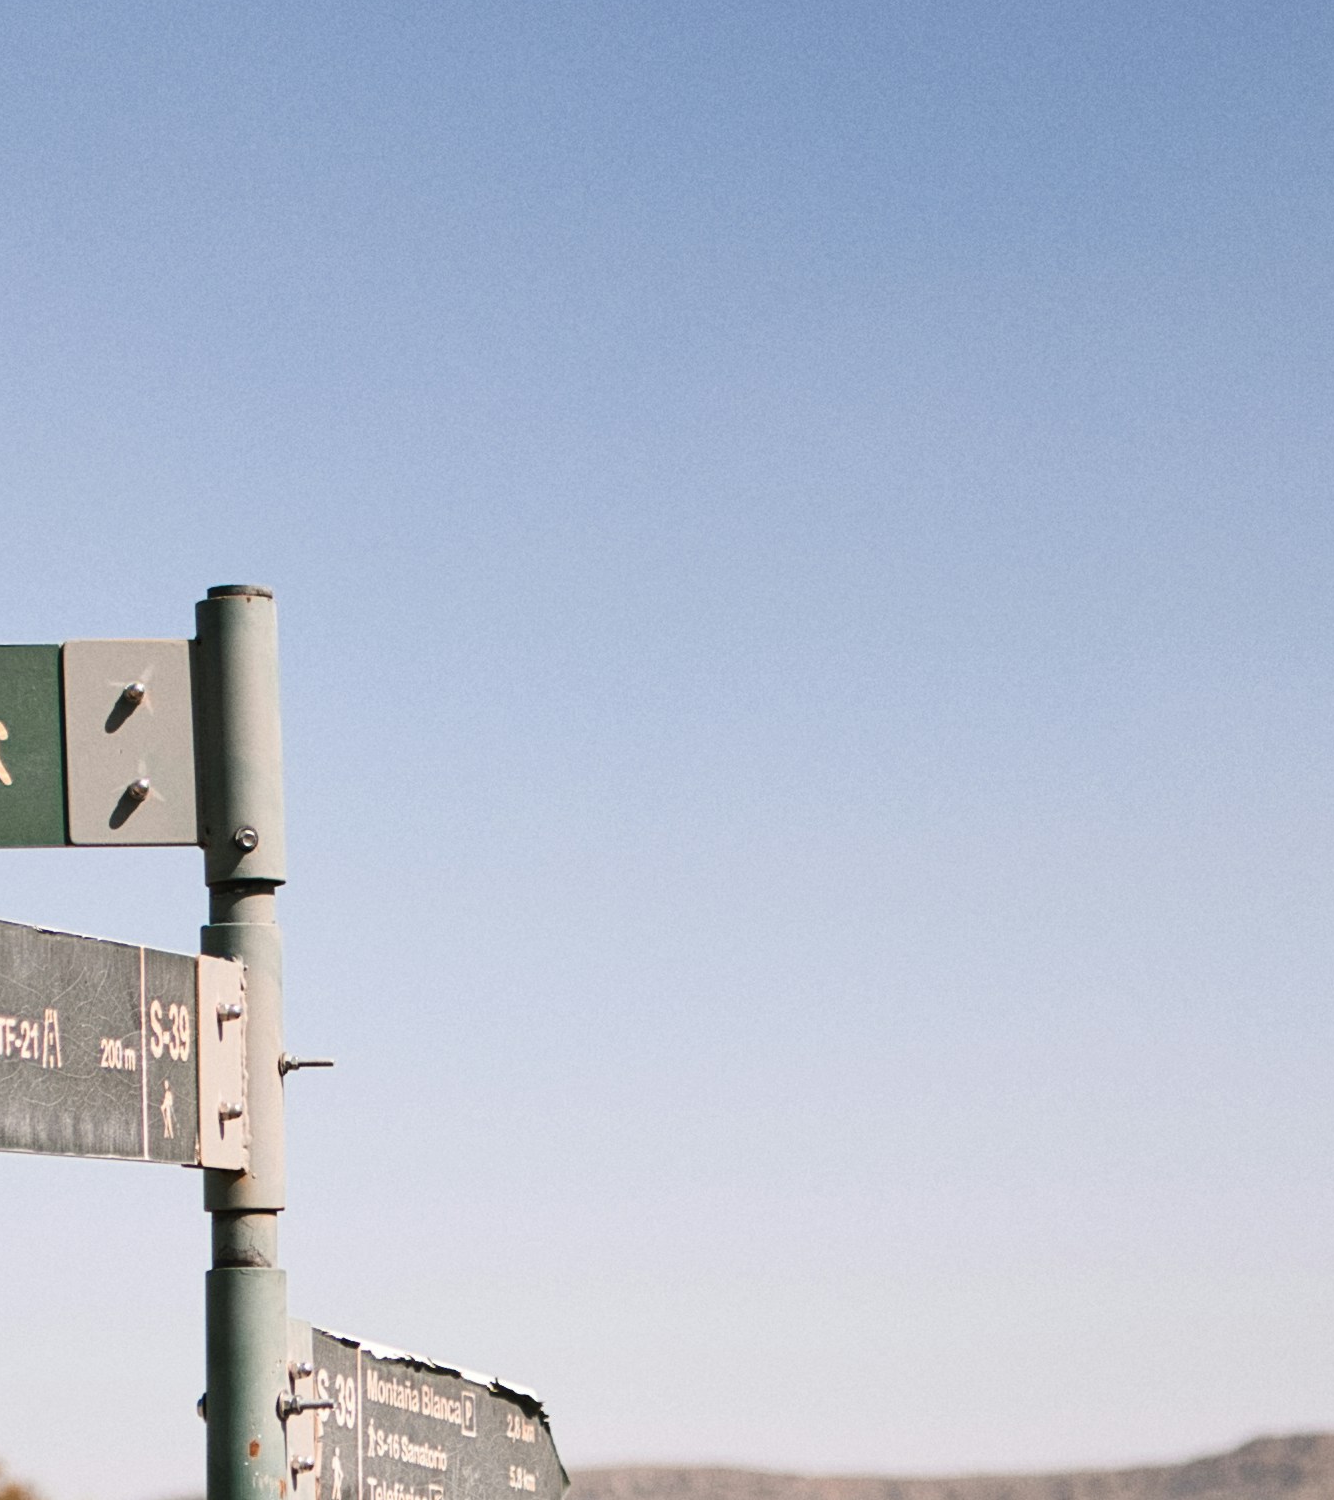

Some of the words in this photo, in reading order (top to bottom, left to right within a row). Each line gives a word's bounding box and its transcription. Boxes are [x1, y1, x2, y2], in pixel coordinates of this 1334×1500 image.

[100, 1037, 123, 1070] 200
[123, 1046, 136, 1071] m
[149, 999, 191, 1062] S-39
[366, 1369, 420, 1416] Montaña
[421, 1384, 462, 1425] Blanca
[521, 1417, 536, 1443] km
[376, 1429, 400, 1460] S-16
[400, 1435, 448, 1472] Sanatorio
[523, 1467, 536, 1493] km
